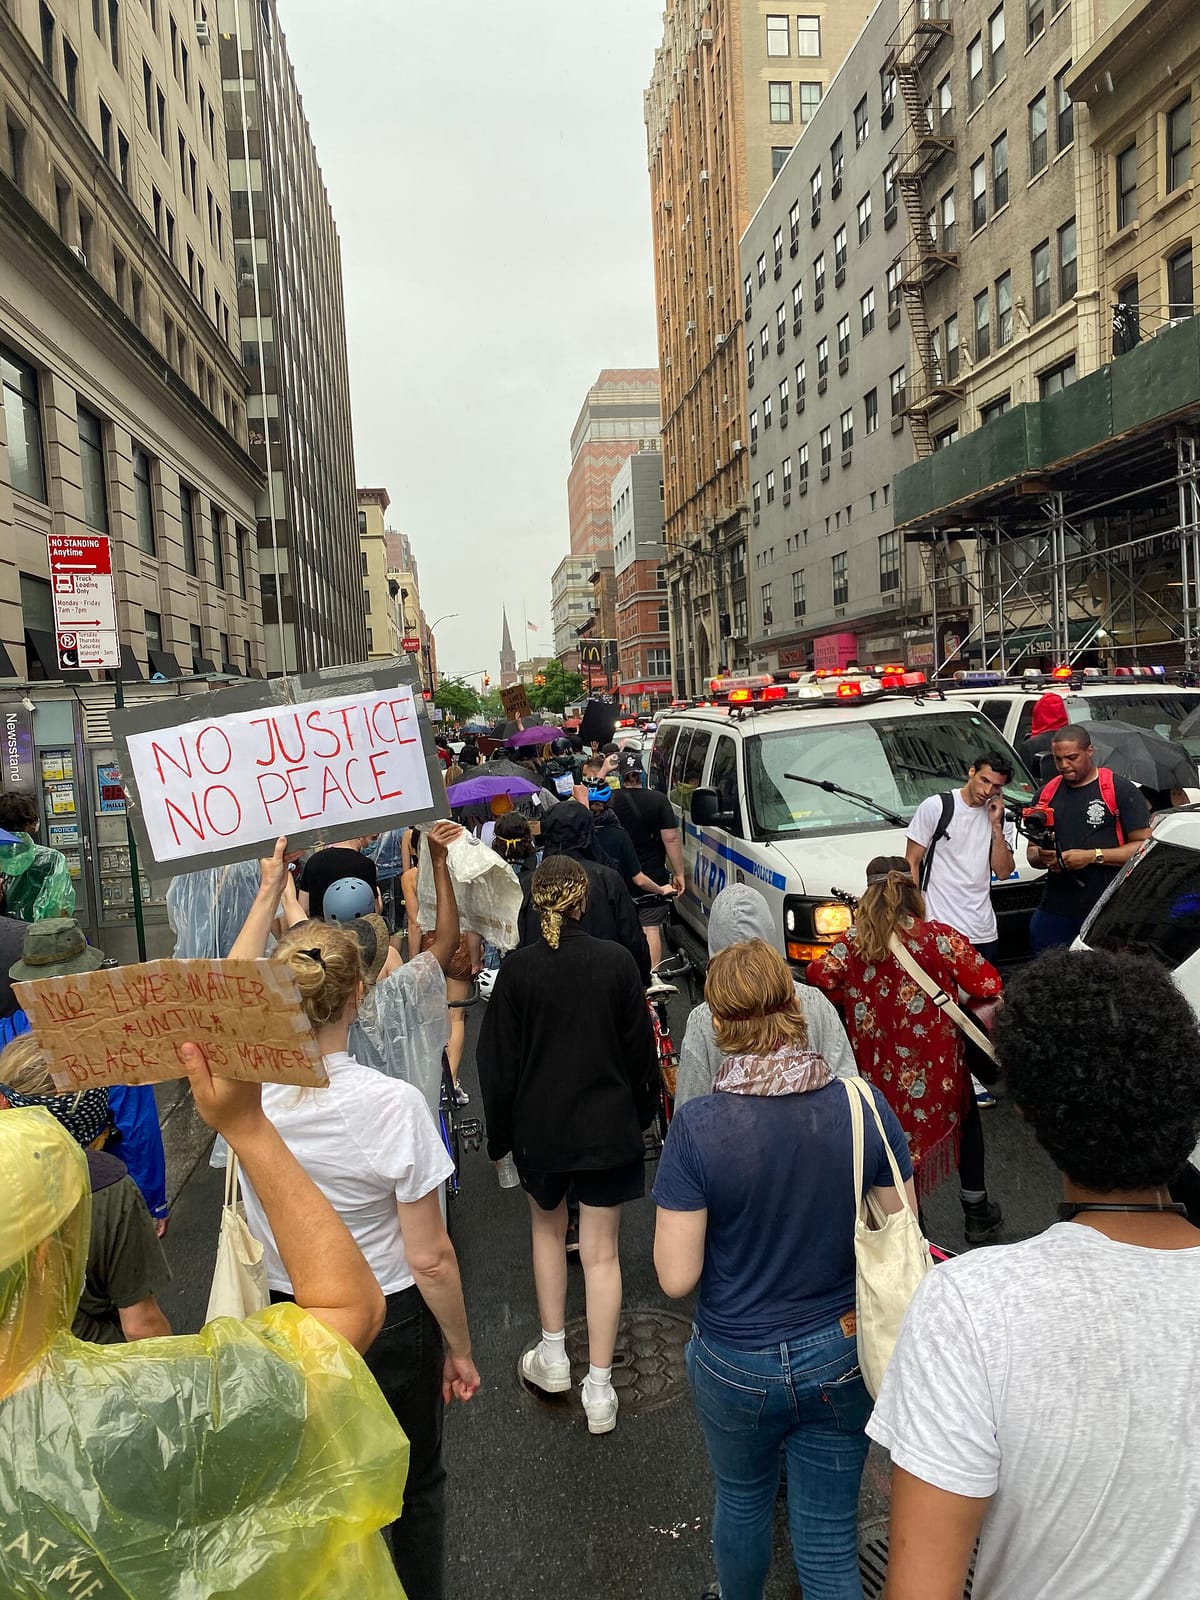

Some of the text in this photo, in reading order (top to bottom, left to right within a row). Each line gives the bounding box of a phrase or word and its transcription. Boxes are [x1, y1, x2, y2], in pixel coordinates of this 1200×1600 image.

[51, 539, 100, 548] NO STANDING
[53, 548, 83, 557] Anytime
[5, 713, 22, 781] Newsstand
[151, 697, 417, 785] NO JUSTICE
[164, 750, 402, 846] NO PEACE
[694, 851, 726, 898] NYPD
[753, 863, 773, 884] POLICE
[40, 972, 268, 1020] NO LIVES MATTER
[60, 1048, 159, 1081] BLACK
[236, 1041, 312, 1071] MATTER
